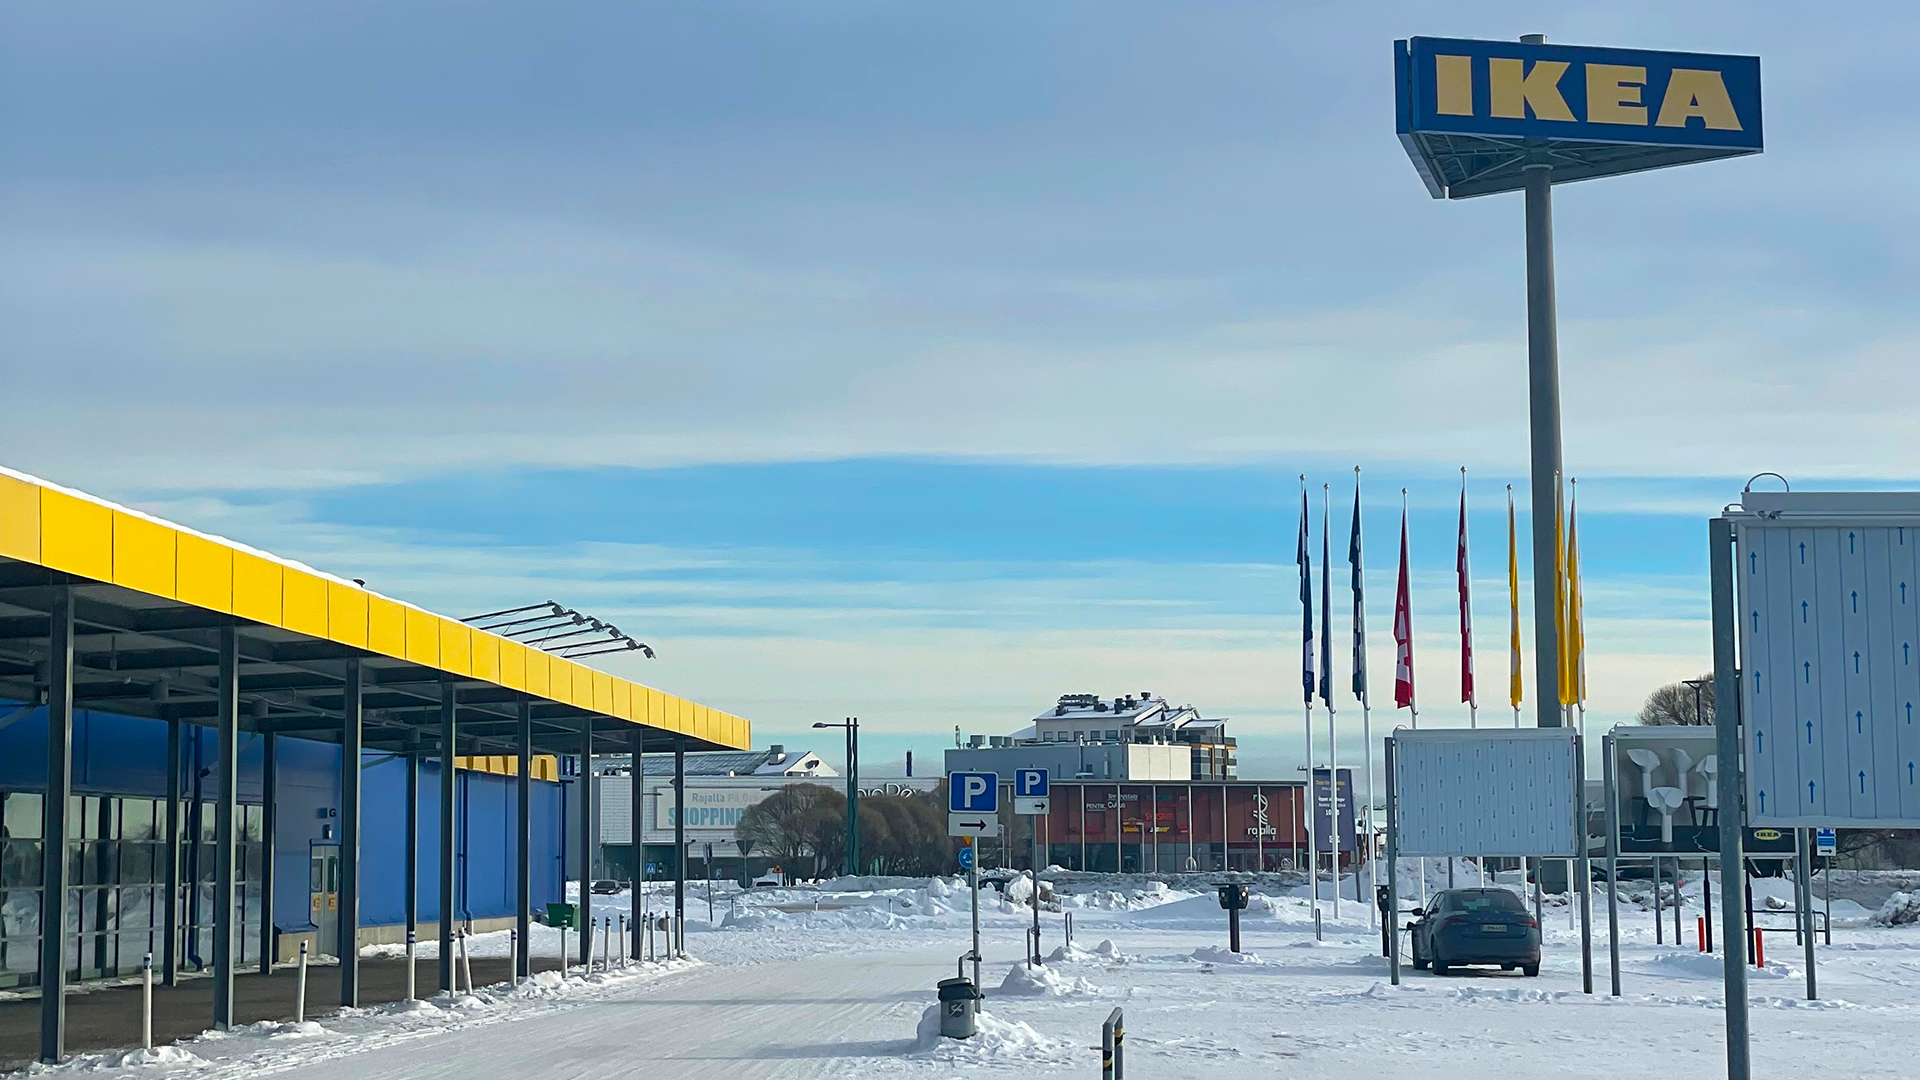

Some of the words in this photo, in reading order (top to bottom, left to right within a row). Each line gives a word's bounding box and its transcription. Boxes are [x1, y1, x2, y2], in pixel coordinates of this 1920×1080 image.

[1435, 55, 1743, 131] IKEA
[1025, 772, 1041, 794] P
[964, 776, 986, 808] P
[692, 793, 725, 807] Rajalla
[1107, 801, 1126, 809] Cuus
[329, 808, 337, 817] G
[1247, 824, 1277, 837] raalla
